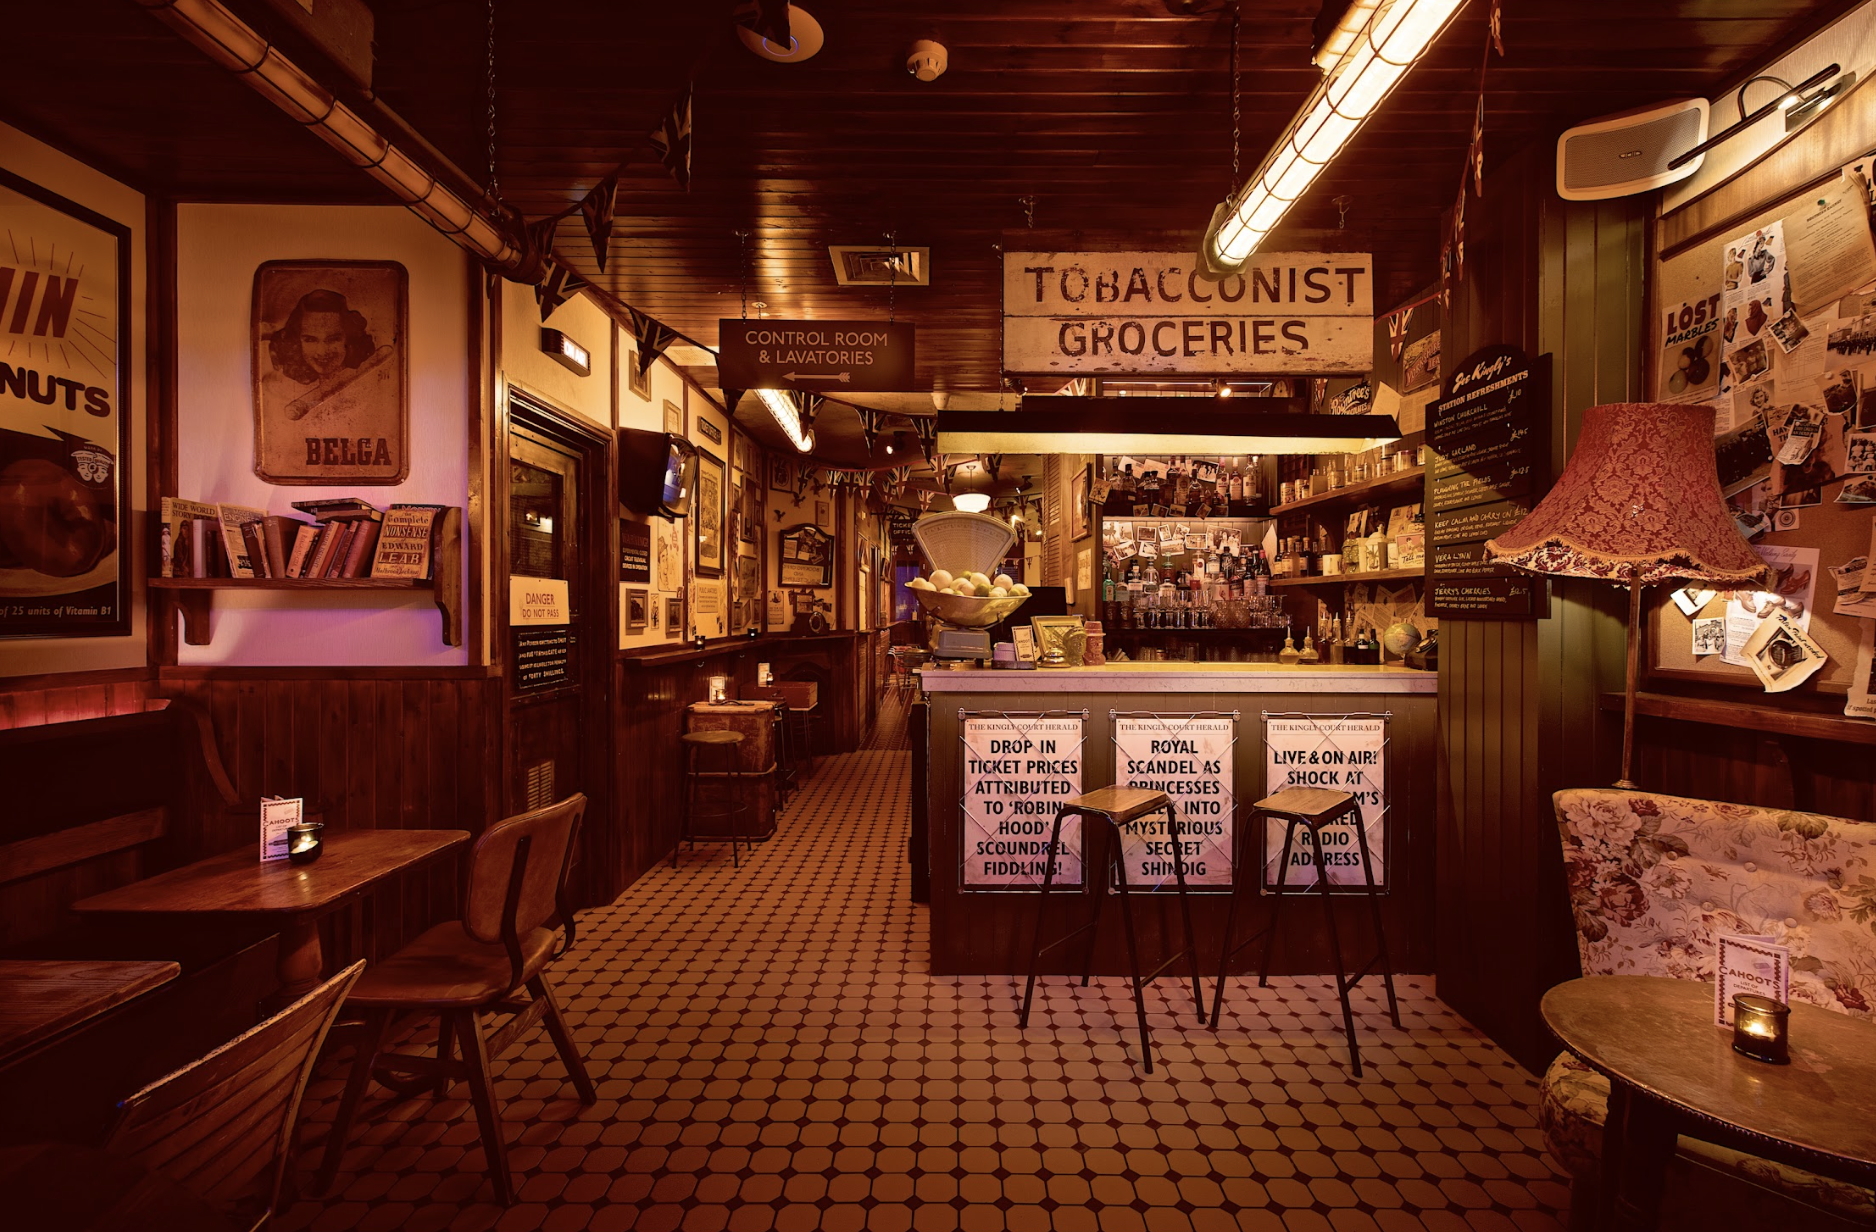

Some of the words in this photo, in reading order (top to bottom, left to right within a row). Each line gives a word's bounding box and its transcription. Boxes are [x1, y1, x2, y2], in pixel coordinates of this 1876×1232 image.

[1024, 266, 1366, 303] TOBACCONIST
[1667, 292, 1721, 336] LOST
[745, 330, 830, 346] CONTROL
[835, 332, 888, 347] ROOM
[1058, 320, 1310, 357] GROCERIES
[1665, 318, 1720, 348] MARBLES
[758, 350, 770, 364] &
[776, 350, 874, 365] LAVATORIES
[0, 362, 110, 418] NUTS
[1438, 395, 1466, 412] STATION
[1466, 370, 1529, 402] REFRESHMENTS
[305, 437, 392, 466] BELGA
[172, 501, 188, 512] WIDE
[190, 504, 215, 516] WORLD
[1435, 519, 1449, 529] KEEP
[1451, 516, 1469, 526] CALM
[1469, 514, 1480, 522] AND
[1480, 511, 1501, 521] CARRY
[1502, 510, 1512, 519] ON
[384, 525, 428, 538] NONSENSE
[382, 542, 423, 551] EDWARD
[1435, 553, 1452, 564] VERA
[1452, 551, 1472, 560] LYNN
[525, 592, 556, 606] DANGER
[12, 605, 24, 616] 25
[27, 605, 51, 616] units
[53, 605, 64, 618] of
[65, 605, 98, 616] Vitamin
[100, 605, 111, 616] B1
[522, 608, 532, 618] DO
[533, 608, 546, 618] NOT
[547, 608, 560, 618] PASS
[970, 723, 988, 731] THE
[988, 723, 1018, 732] KINGLY
[1018, 723, 1046, 731] COURT
[1047, 723, 1079, 731] HERALD
[1120, 723, 1138, 731] THE
[1138, 723, 1168, 732] KINGLY
[1168, 723, 1197, 731] COURT
[1197, 723, 1229, 731] HERALD
[1270, 723, 1288, 731] THE
[1289, 723, 1318, 732] KINGLY
[1319, 723, 1347, 731] COURT
[1348, 723, 1381, 731] HERALD
[990, 740, 1033, 754] DROP
[1041, 740, 1056, 753] IN
[1151, 740, 1198, 754] ROYAL
[1347, 750, 1377, 764] AIR!
[968, 760, 1022, 774] TICKET
[1027, 760, 1078, 774] PRICES
[1127, 760, 1198, 774] SCANDEL
[1203, 760, 1221, 774] AS
[1287, 771, 1339, 785] SHOCK
[1345, 771, 1363, 784] AT
[975, 780, 1072, 794] ATTRIBUTED
[983, 801, 1004, 815] TO
[1184, 801, 1220, 815] INTO
[1301, 832, 1349, 845] RDIO
[976, 841, 1070, 855] SCOUNDREL
[1145, 841, 1202, 855] SECRET
[1290, 852, 1360, 866] ADRESS
[1141, 862, 1206, 876] SHINDIG
[1718, 965, 1781, 991] CAHOOTS
[1733, 983, 1766, 996] DEPARTURES
